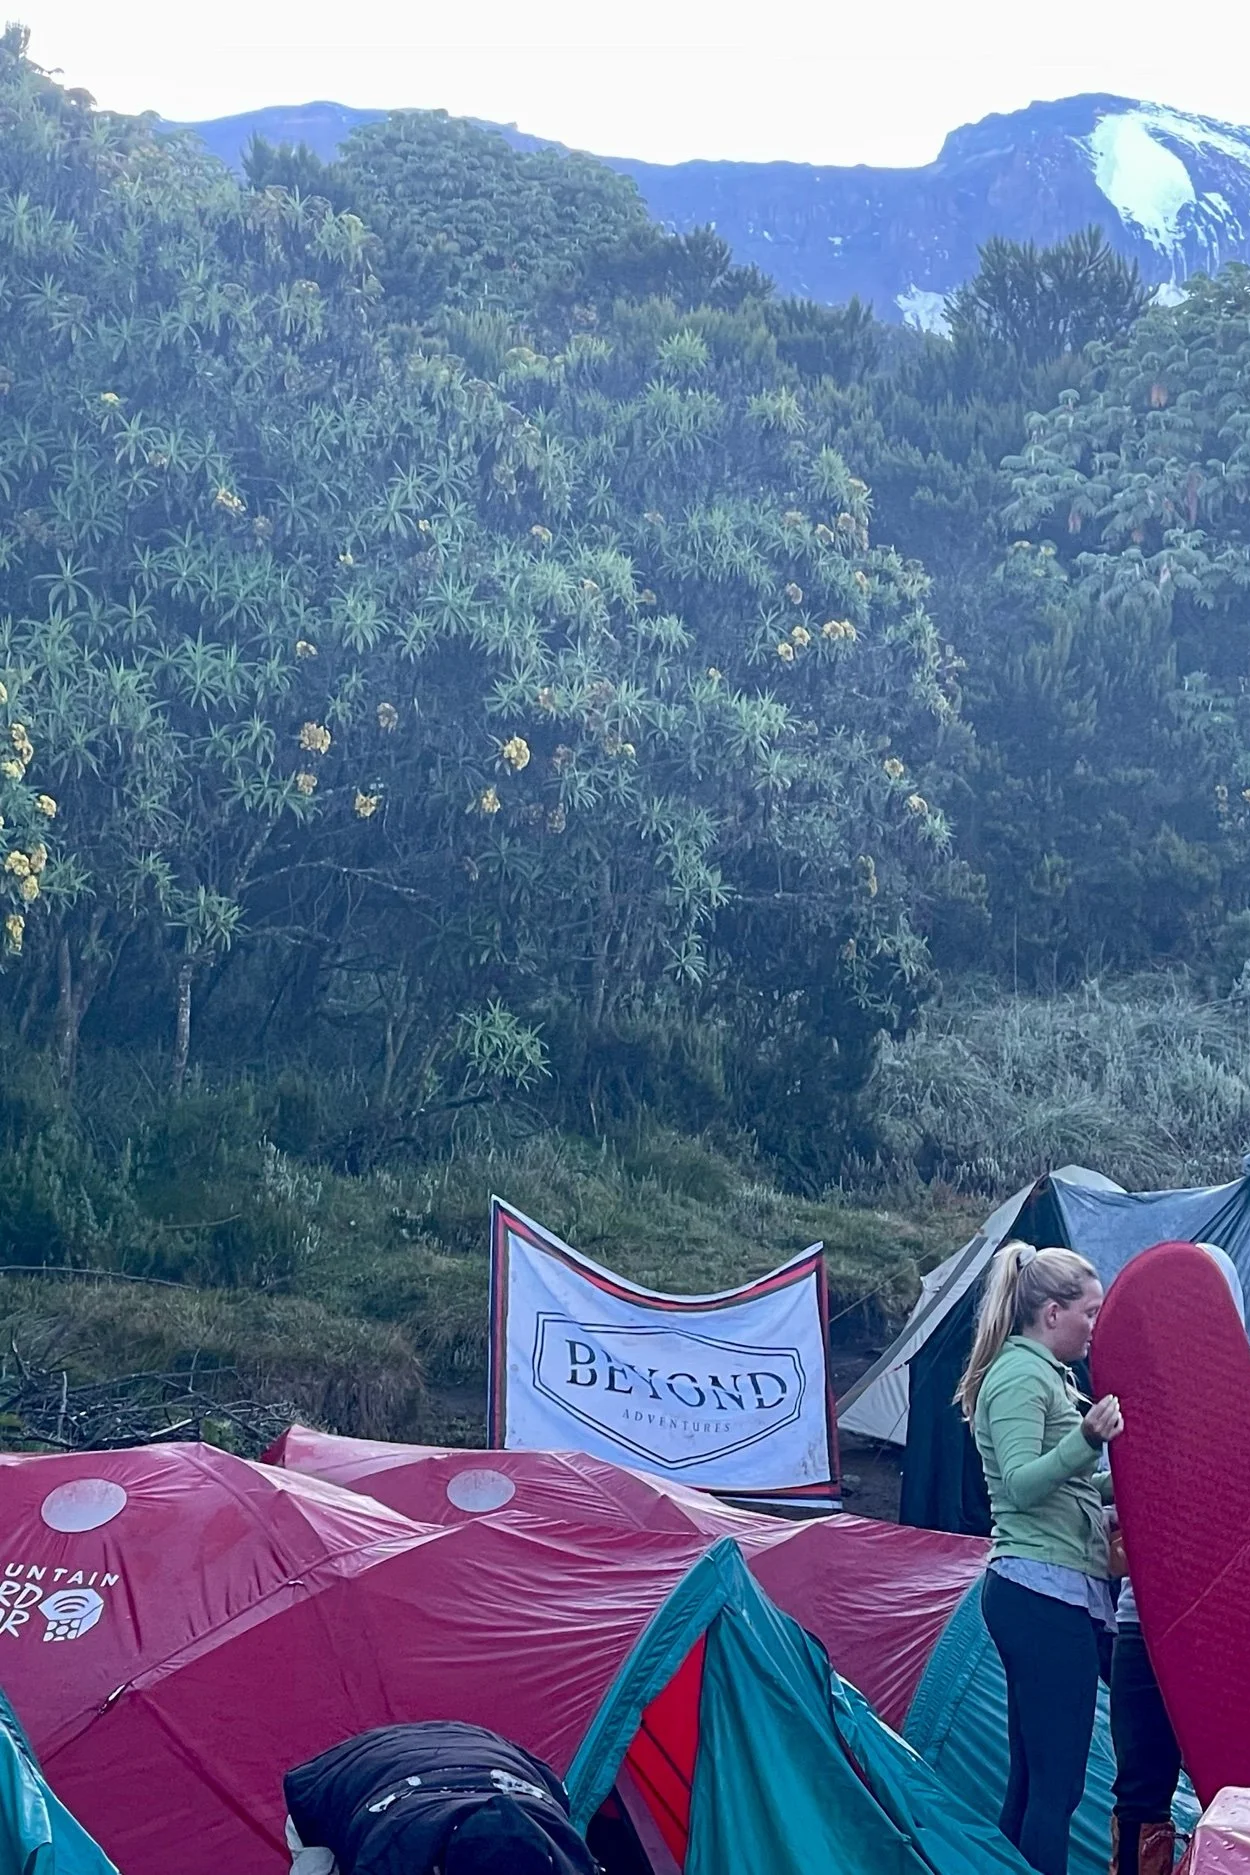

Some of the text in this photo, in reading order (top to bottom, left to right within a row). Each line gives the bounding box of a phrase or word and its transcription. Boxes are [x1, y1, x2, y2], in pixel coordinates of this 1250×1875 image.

[565, 1339, 788, 1411] BEYOND
[622, 1408, 731, 1433] ADVENTURES
[0, 1607, 30, 1638] R
